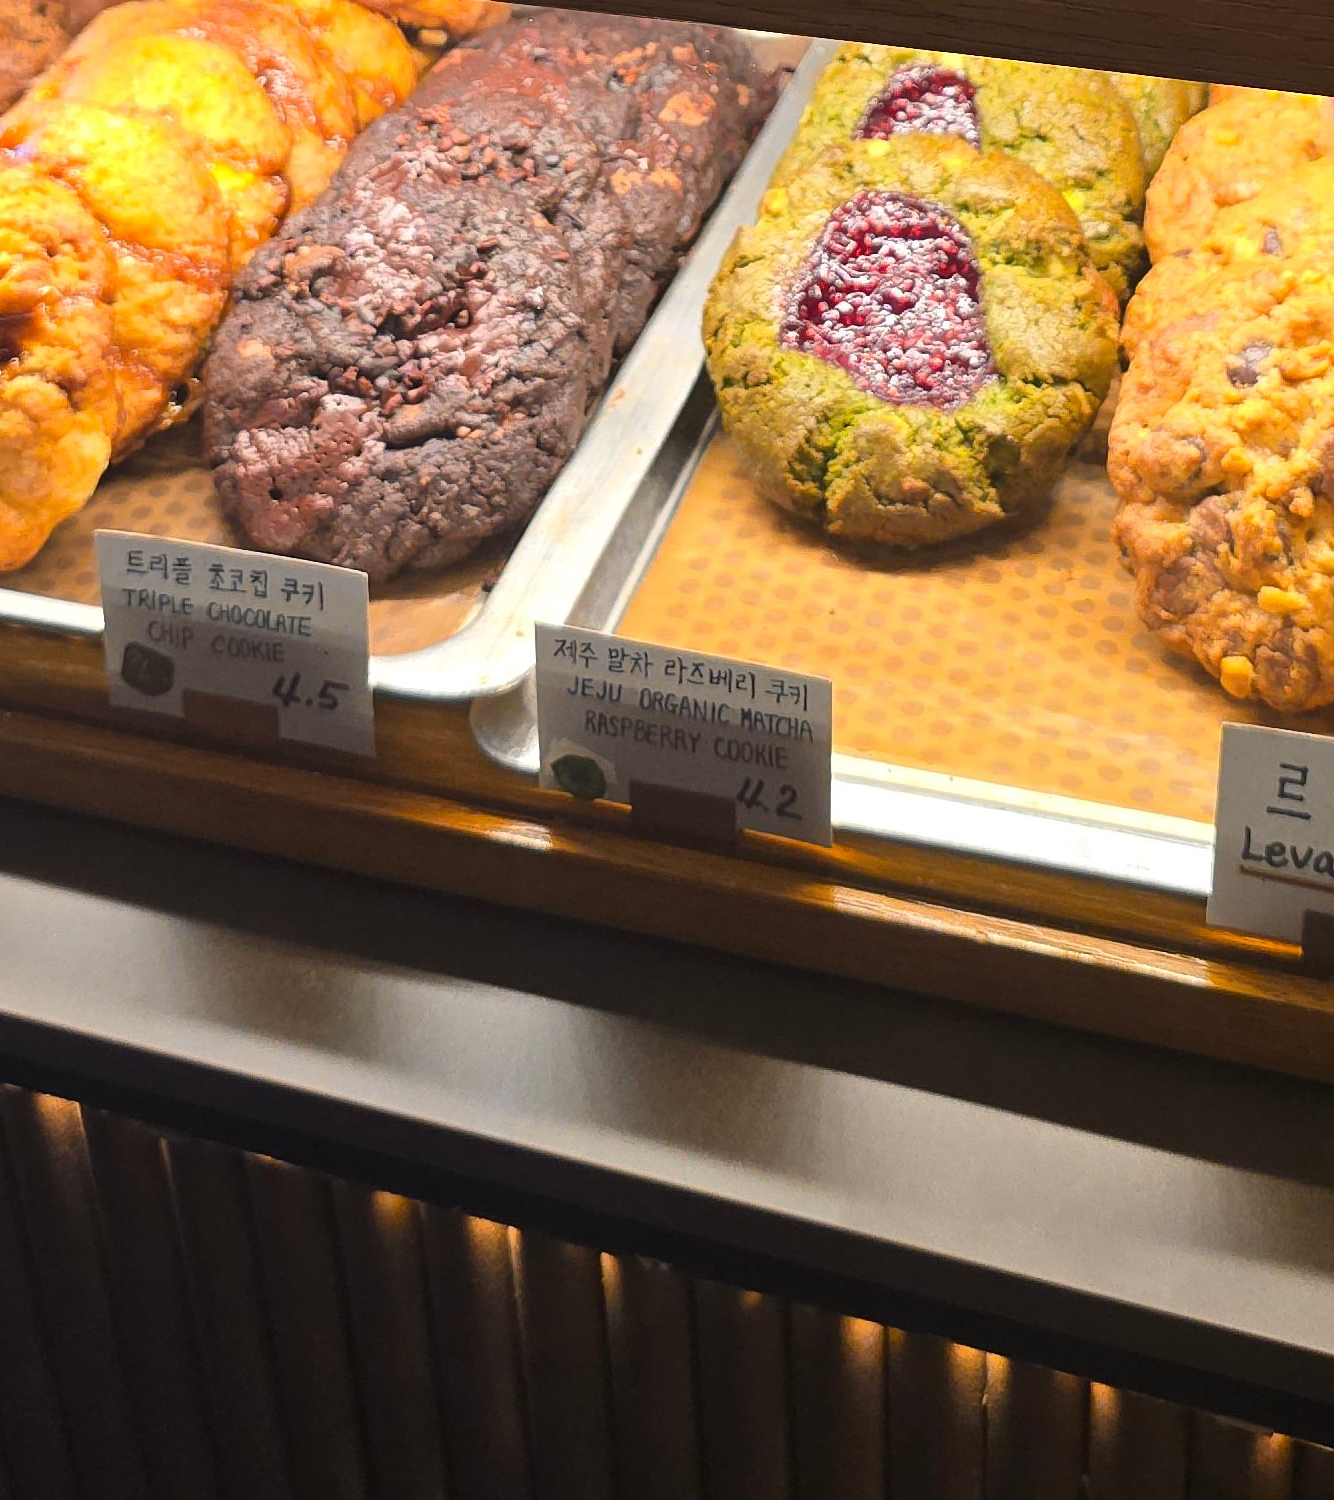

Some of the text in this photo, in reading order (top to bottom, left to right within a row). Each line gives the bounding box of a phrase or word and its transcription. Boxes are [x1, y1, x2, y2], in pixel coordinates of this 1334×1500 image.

[126, 550, 325, 612] 트리플 초코칩 쿠키
[122, 588, 312, 637] TRIPLE CHOCOLATE
[148, 620, 285, 663] CHIP COOKIE
[272, 671, 349, 711] 4.5
[553, 638, 808, 711] 제주 말차 라즈베리 쿠키
[567, 676, 814, 743] JEJU ORGANIC MATCHA
[584, 709, 790, 770] RASPBERRY COOKIE
